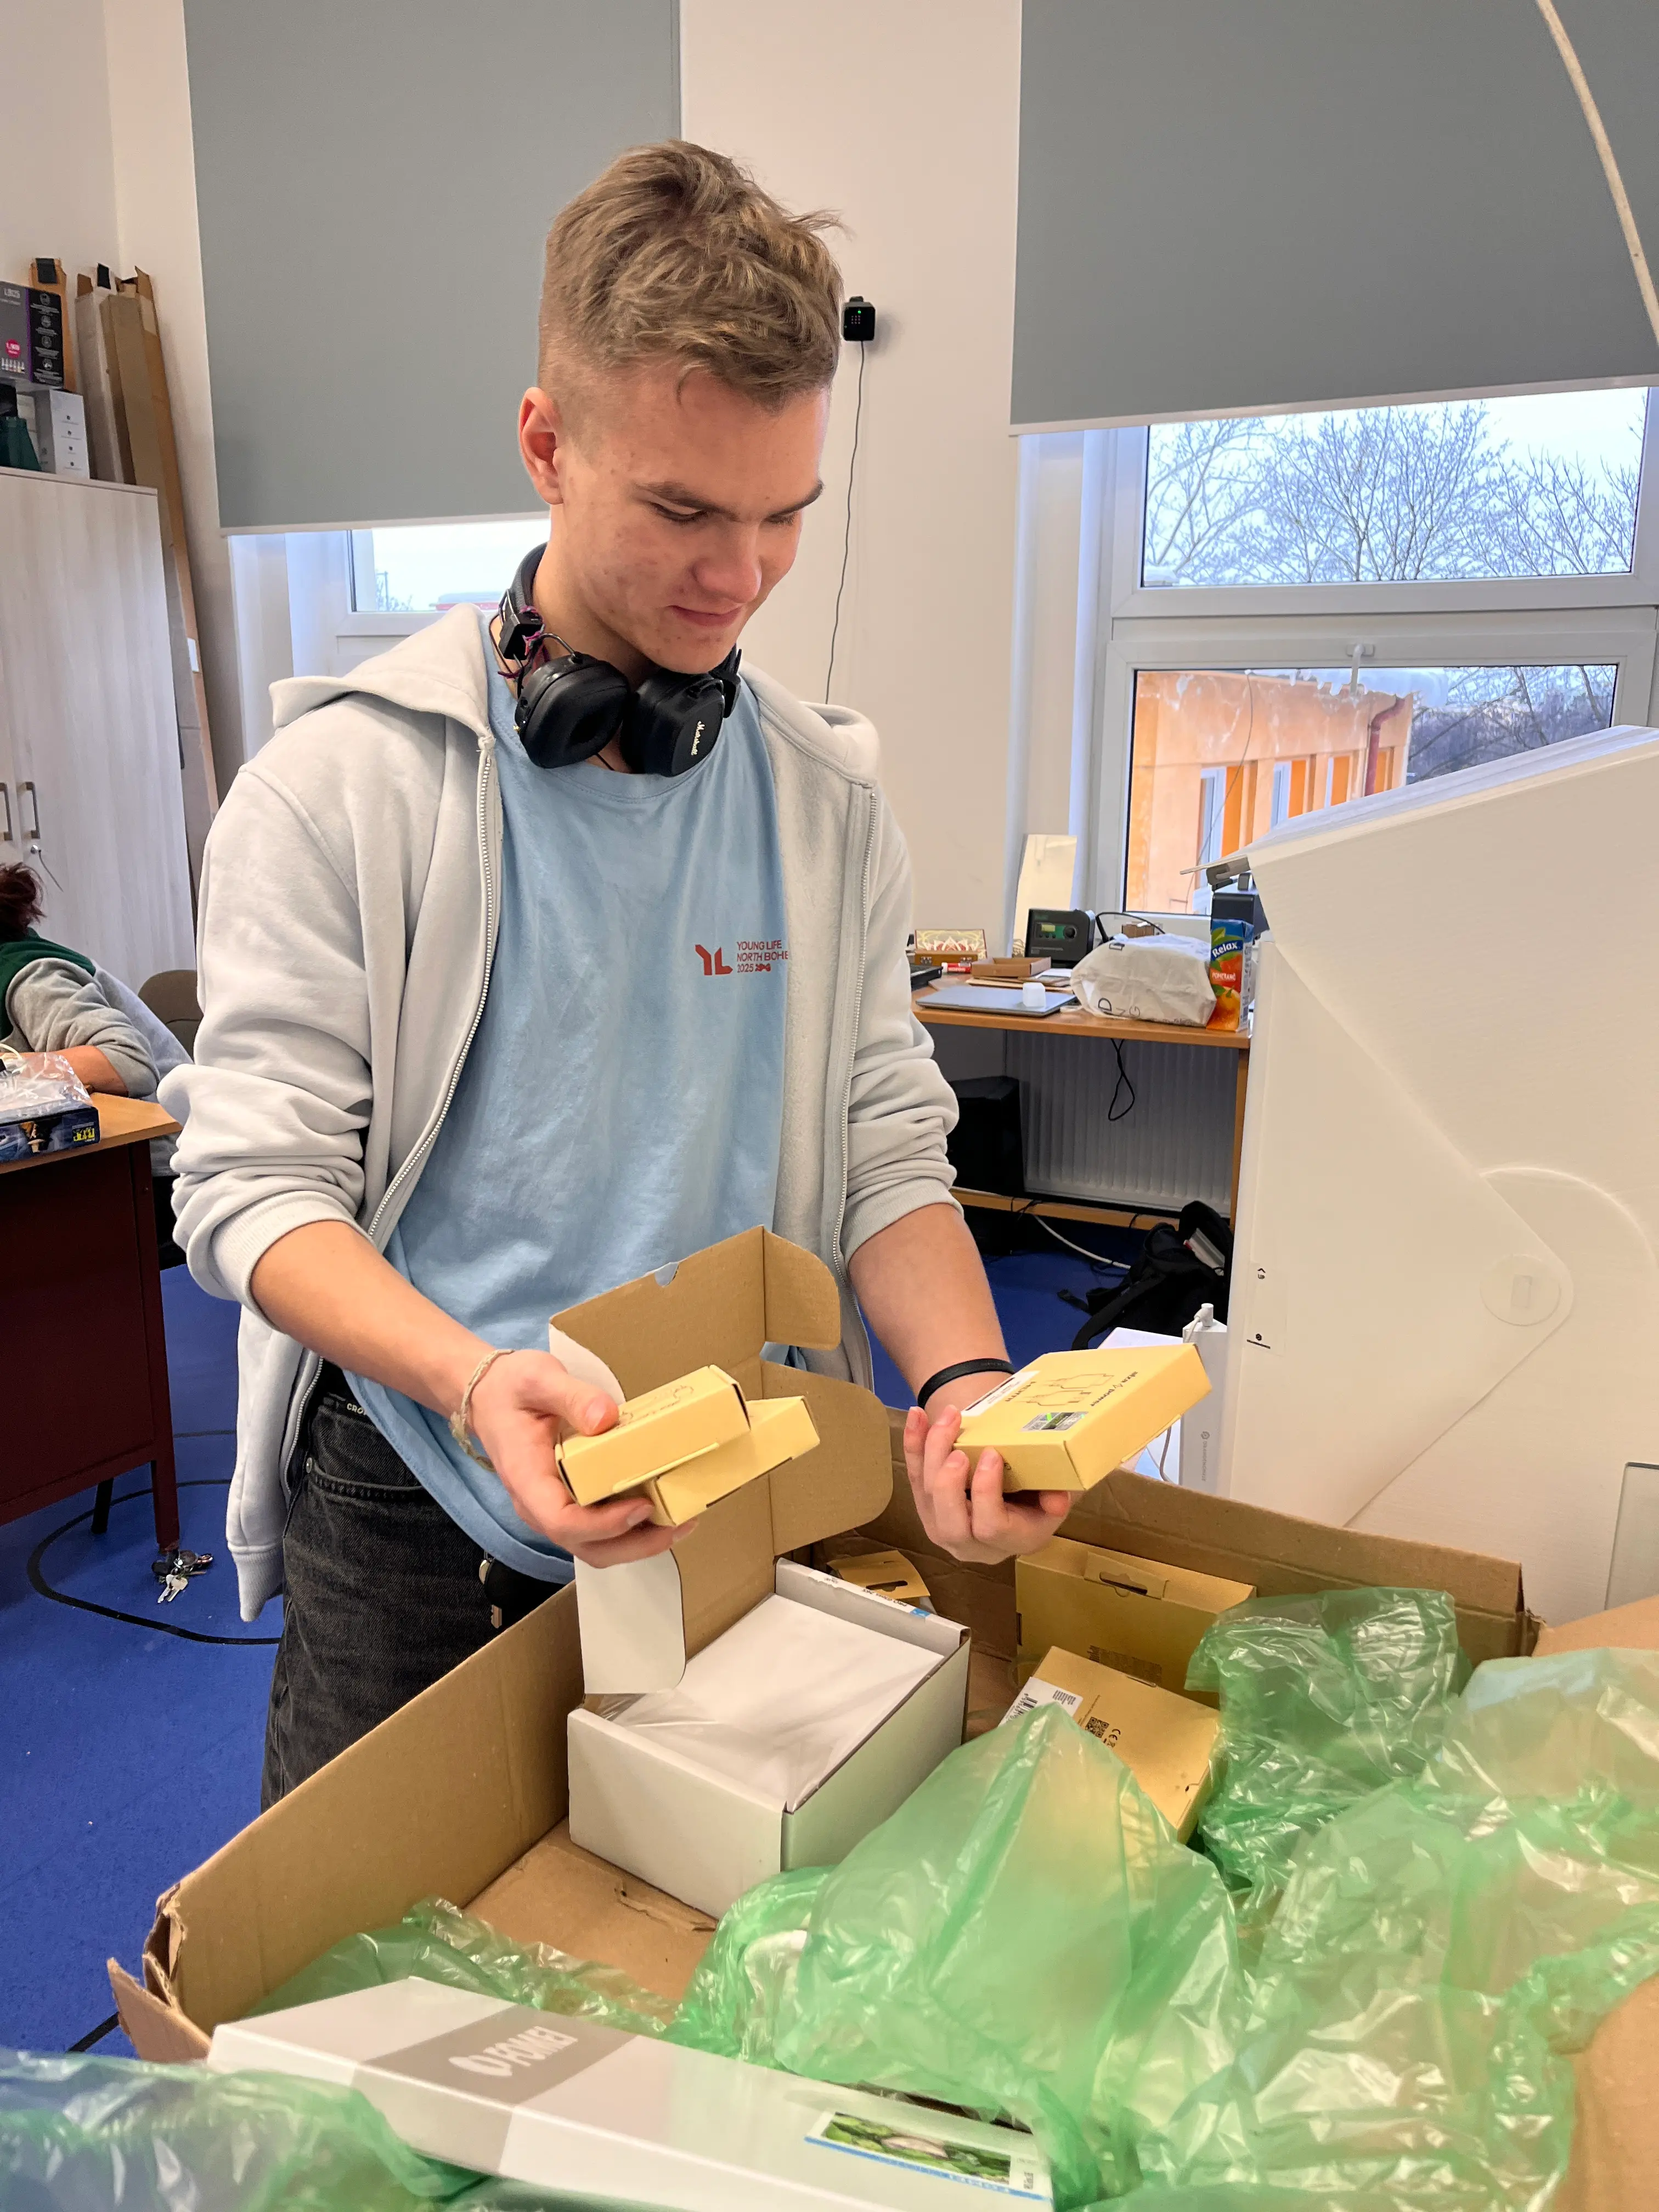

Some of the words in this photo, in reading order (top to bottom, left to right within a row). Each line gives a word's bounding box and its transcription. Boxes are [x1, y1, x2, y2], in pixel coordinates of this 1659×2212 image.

[691, 721, 705, 755] Marshall
[737, 941, 764, 950] YOUNG
[766, 940, 782, 950] LIFE
[1212, 942, 1238, 958] Relax
[737, 952, 763, 962] NORTH
[737, 963, 754, 973] 2025
